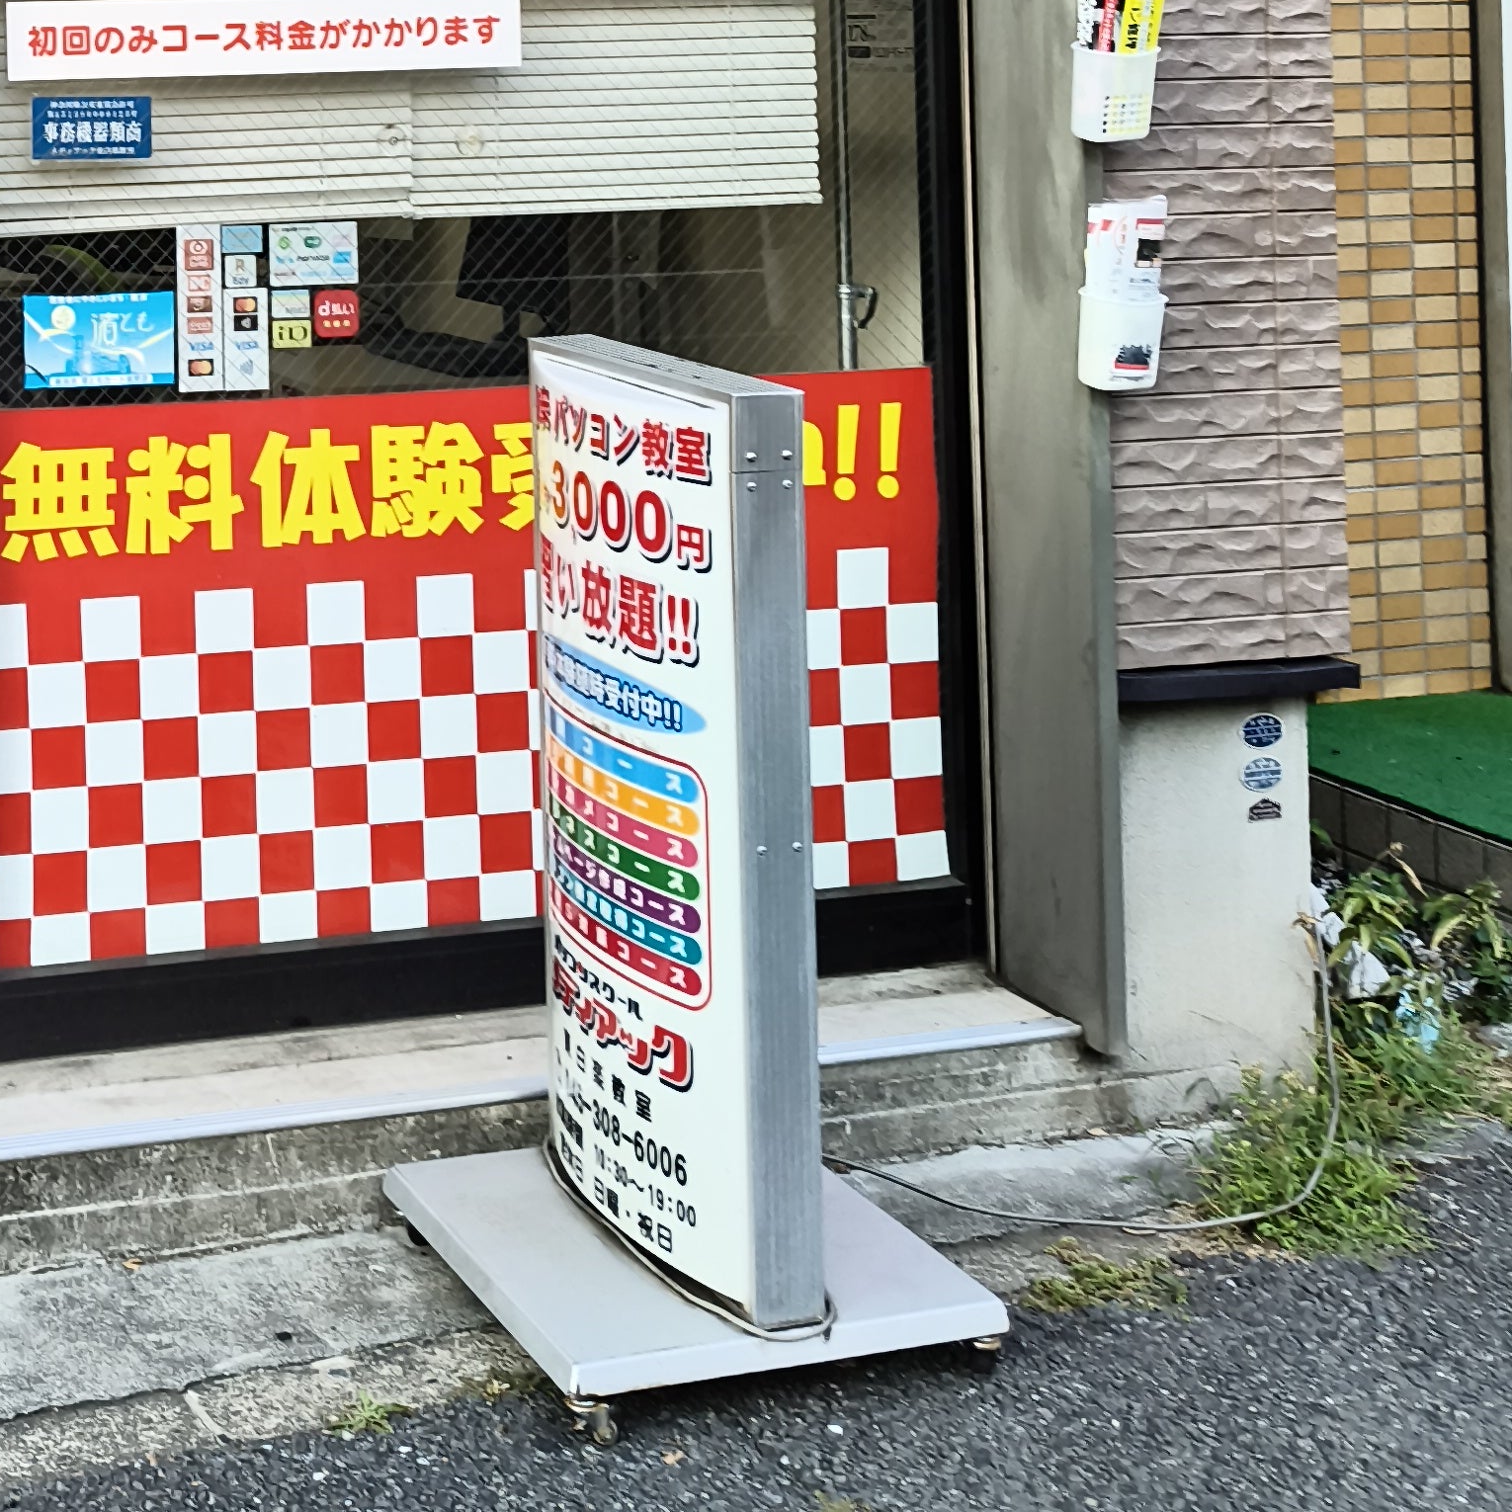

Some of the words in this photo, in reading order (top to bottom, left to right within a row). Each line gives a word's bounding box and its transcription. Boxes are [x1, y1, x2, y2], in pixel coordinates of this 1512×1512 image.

[28, 13, 501, 58] 初回のみコース料金がかかります
